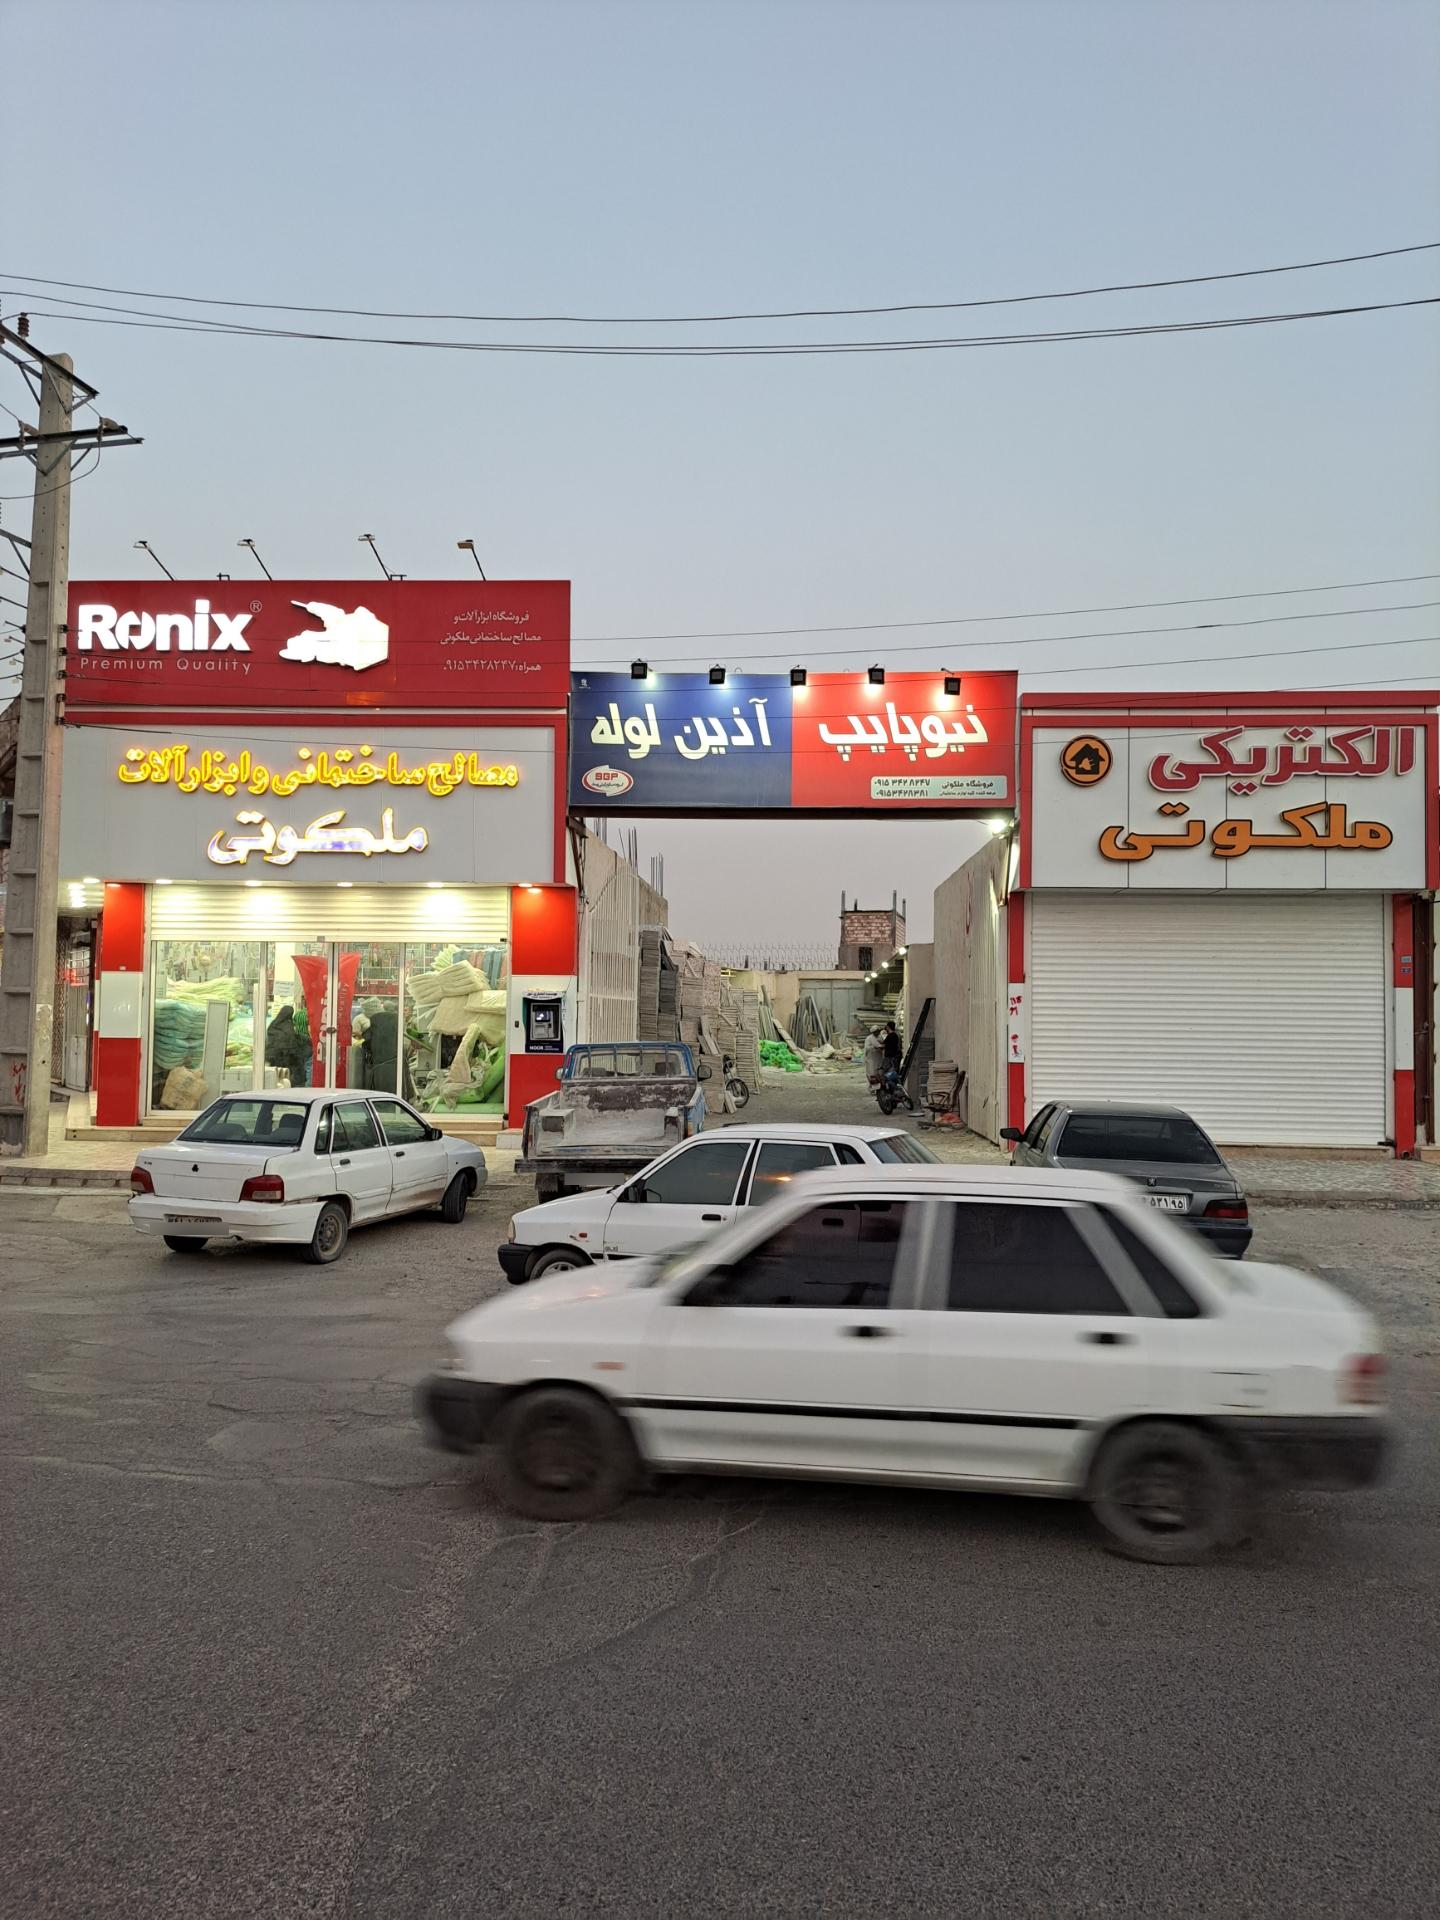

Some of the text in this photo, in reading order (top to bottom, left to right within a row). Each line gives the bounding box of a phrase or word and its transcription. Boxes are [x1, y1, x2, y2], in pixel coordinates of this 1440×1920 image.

[77, 599, 254, 652] Ronix
[440, 631, 542, 645] مصالح ساختمانی ملکوتی
[492, 610, 529, 625] فروشگاه
[80, 657, 252, 675] Premium Quality
[590, 697, 773, 761] آذین لوله
[817, 701, 990, 763] نیوپایپ
[271, 745, 426, 797] ساختمانی
[428, 751, 519, 797] مصالح
[941, 779, 994, 790] فروشگاه ملکوتی
[1148, 724, 1417, 796] الکتریکی
[206, 806, 430, 866] ملکوتی
[1098, 801, 1394, 862] ملکوتی
